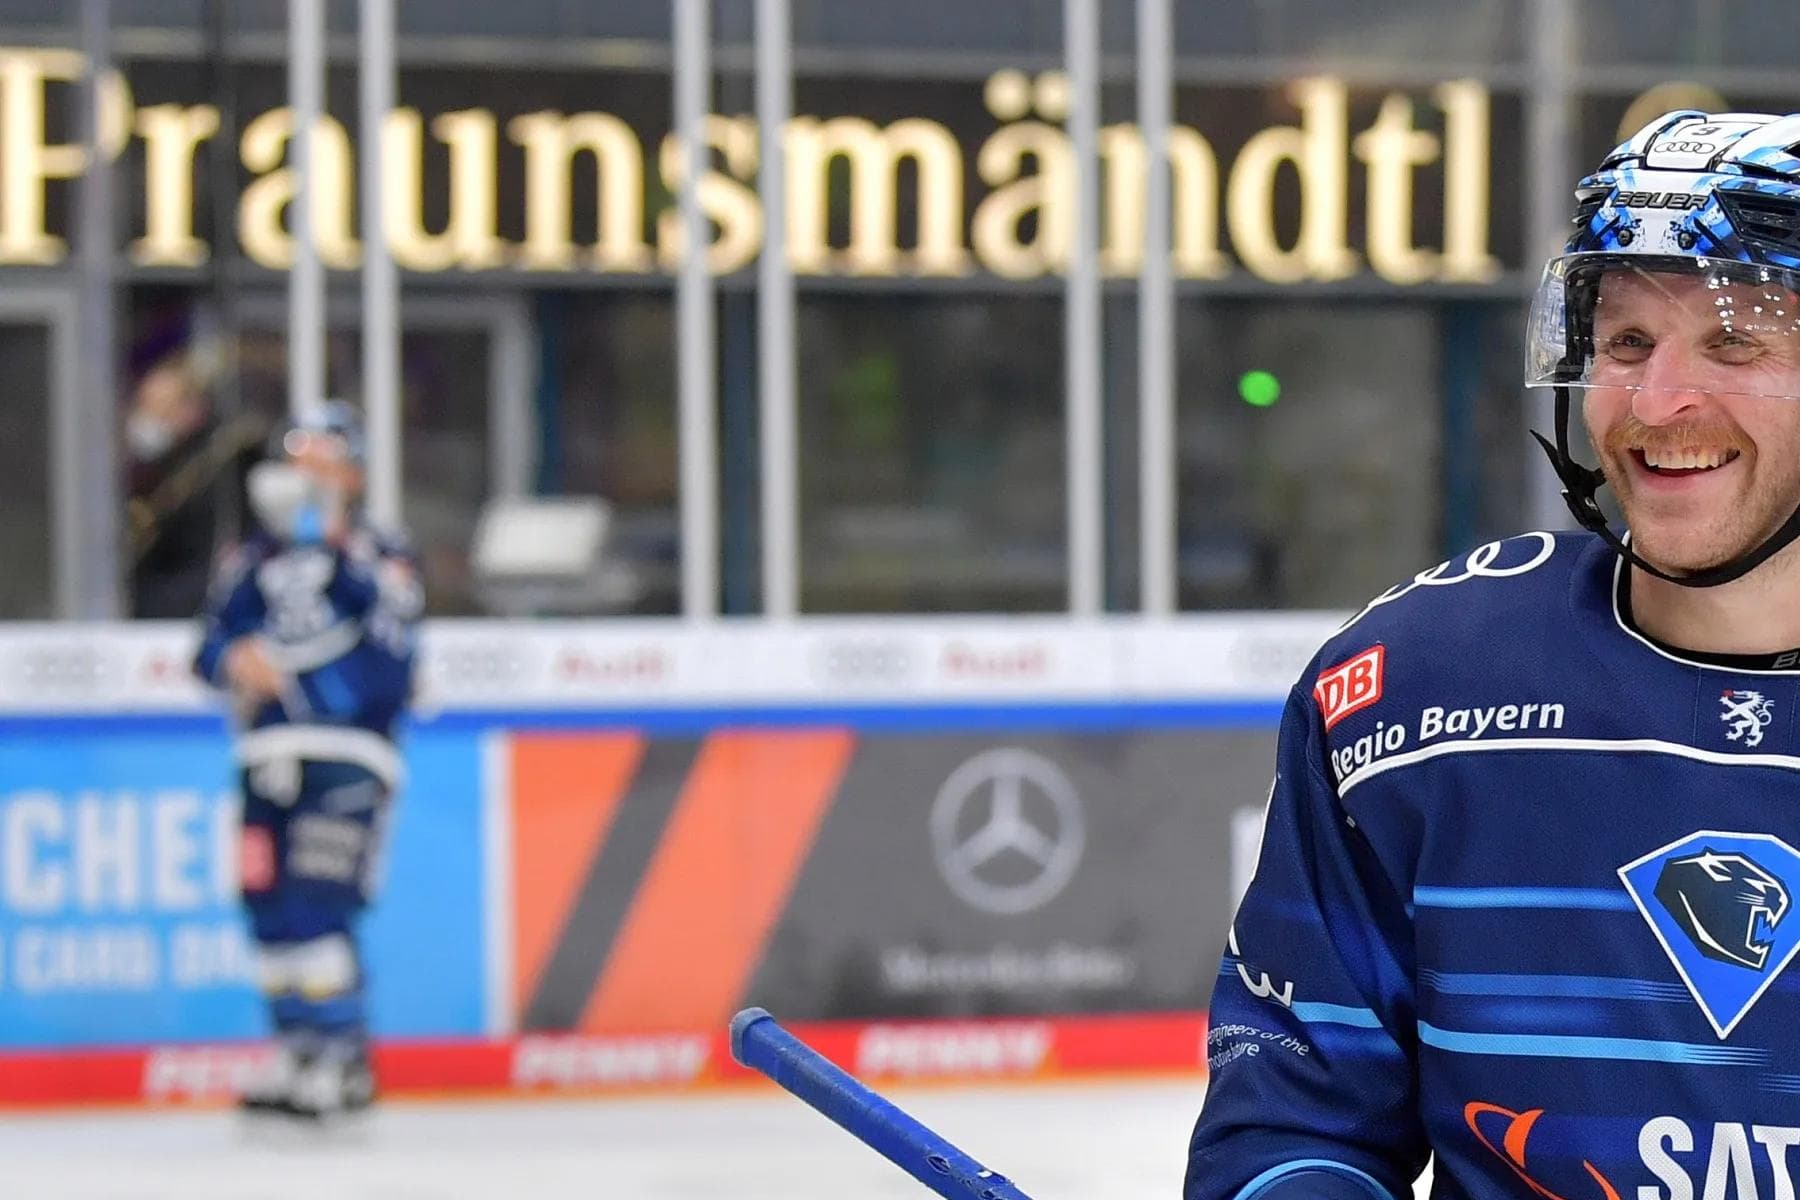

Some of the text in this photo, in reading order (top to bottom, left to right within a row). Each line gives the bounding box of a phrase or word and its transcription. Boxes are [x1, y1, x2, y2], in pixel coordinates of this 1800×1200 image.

[0, 47, 1504, 285] Praunsmändtl
[1322, 658, 1374, 716] DB
[1331, 703, 1566, 784] Regio Bayern
[1259, 1032, 1285, 1041] of
[1279, 1033, 1310, 1057] the
